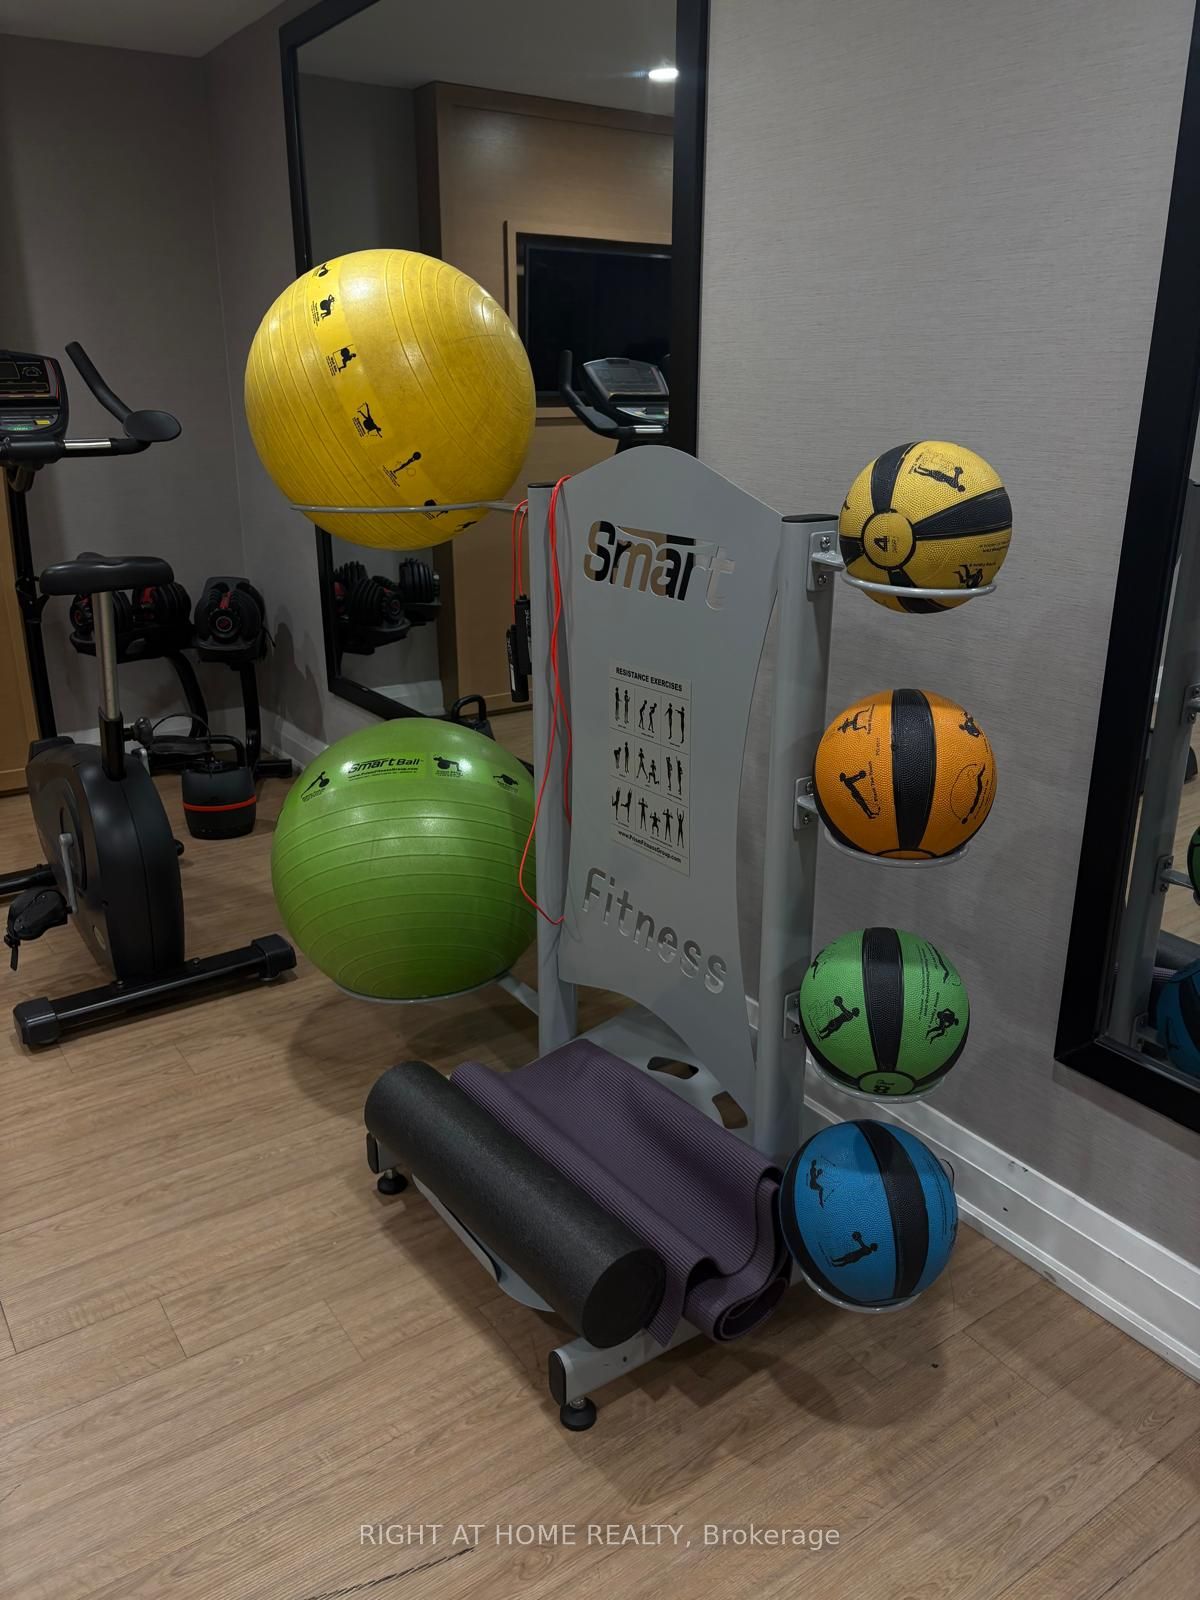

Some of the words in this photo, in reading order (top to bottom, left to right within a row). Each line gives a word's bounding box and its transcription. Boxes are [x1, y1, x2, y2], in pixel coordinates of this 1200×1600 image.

[583, 520, 736, 611] Smart
[874, 535, 889, 552] 4
[615, 667, 649, 683] RESISTANCE
[650, 676, 683, 692] EXERCISES
[582, 867, 727, 994] Fitness
